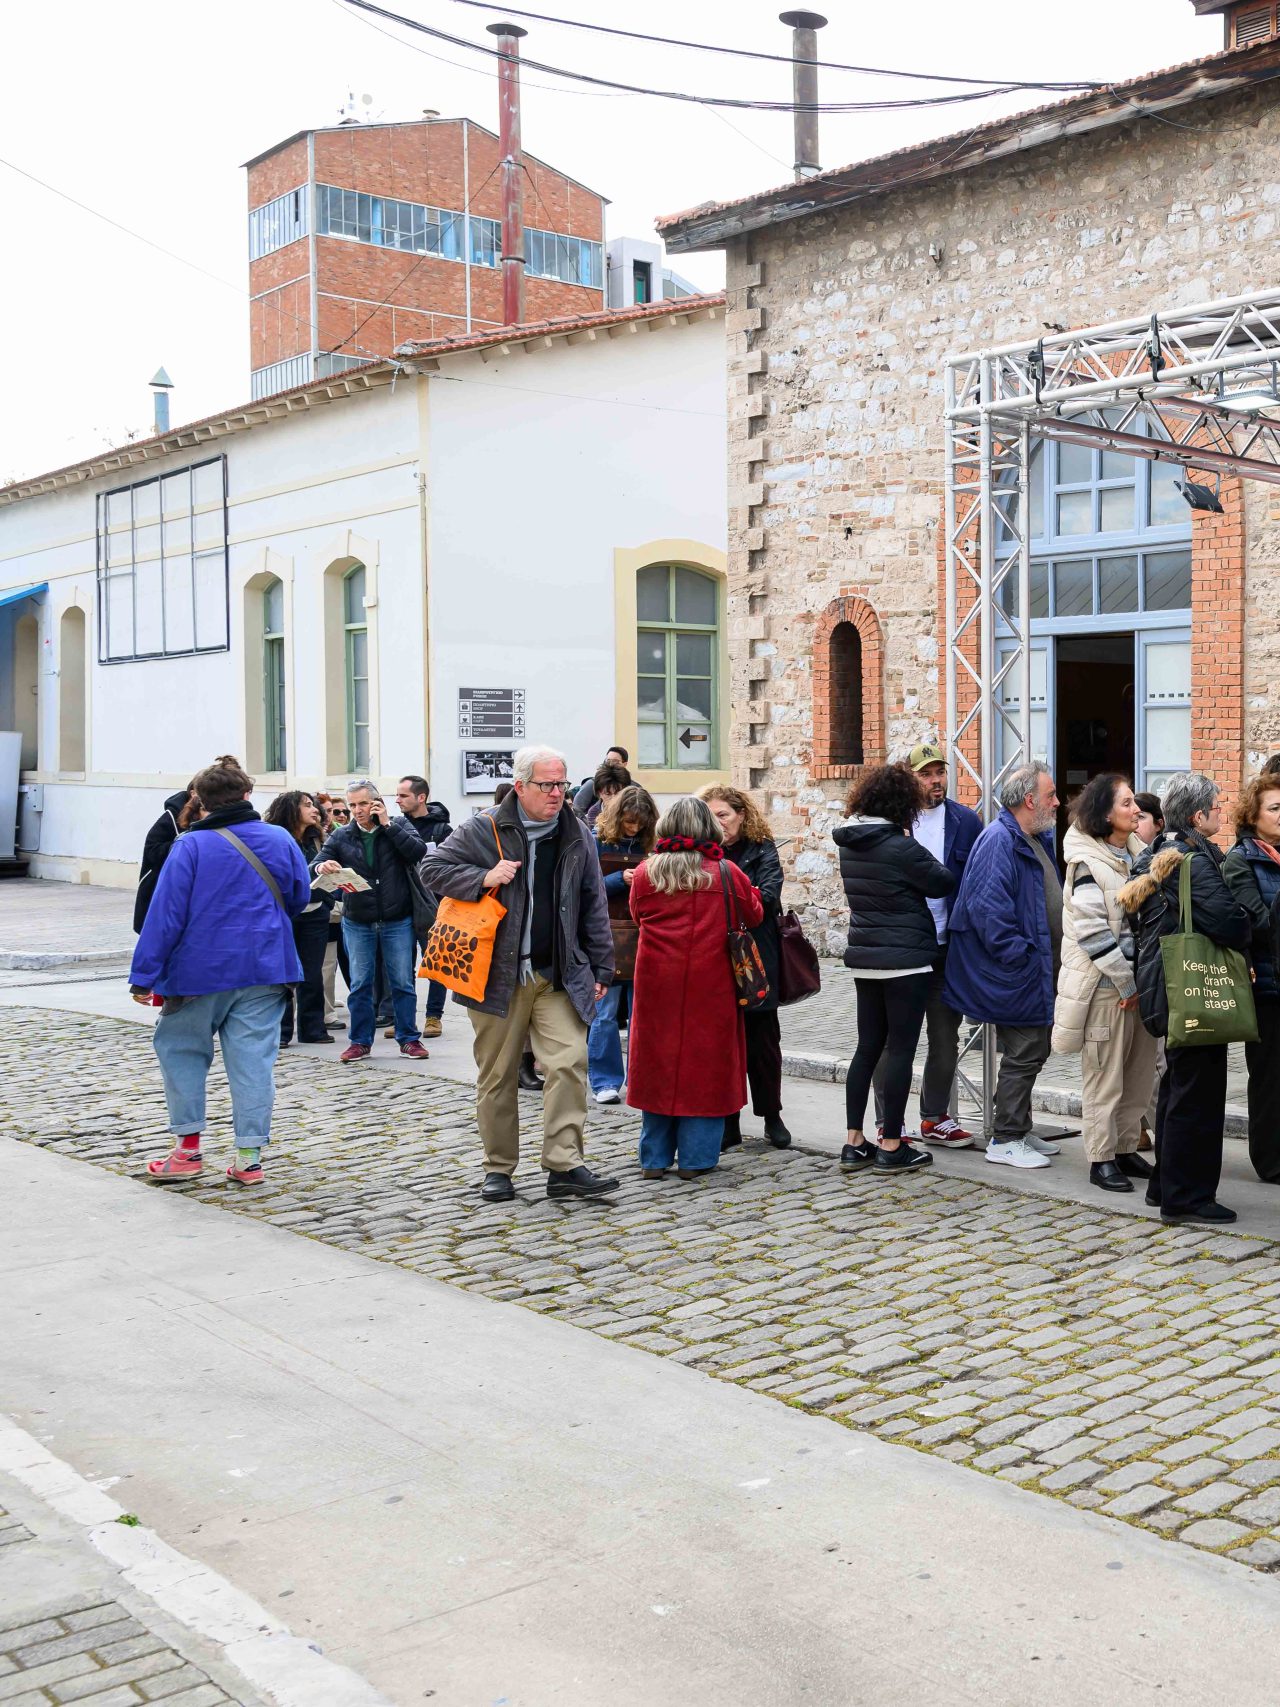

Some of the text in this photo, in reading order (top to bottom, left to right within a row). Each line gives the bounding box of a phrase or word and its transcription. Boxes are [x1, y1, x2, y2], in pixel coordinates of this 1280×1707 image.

[1183, 960, 1228, 975] Keep the
[1204, 975, 1234, 987] drama
[1184, 986, 1220, 997] on the
[1204, 999, 1237, 1010] stage
